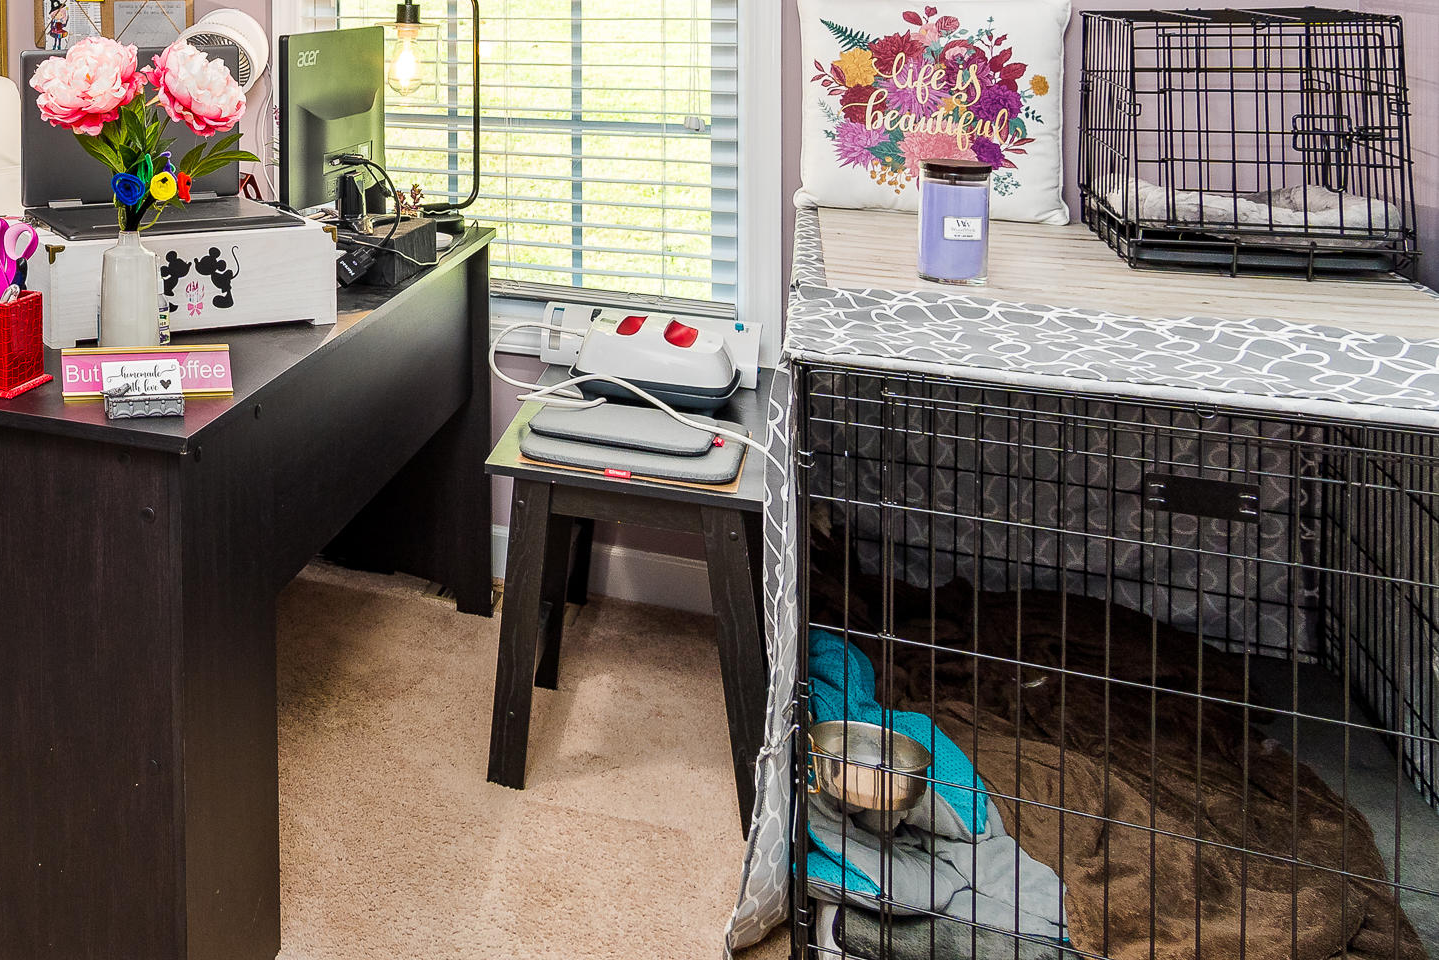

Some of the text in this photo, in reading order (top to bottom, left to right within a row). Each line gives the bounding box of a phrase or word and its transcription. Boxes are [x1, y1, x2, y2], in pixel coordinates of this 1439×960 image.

[297, 49, 320, 67] acer
[872, 52, 982, 107] life is
[837, 89, 1023, 151] beautiful
[65, 359, 226, 383] But offee
[115, 364, 167, 379] homemade
[144, 378, 159, 392] love
